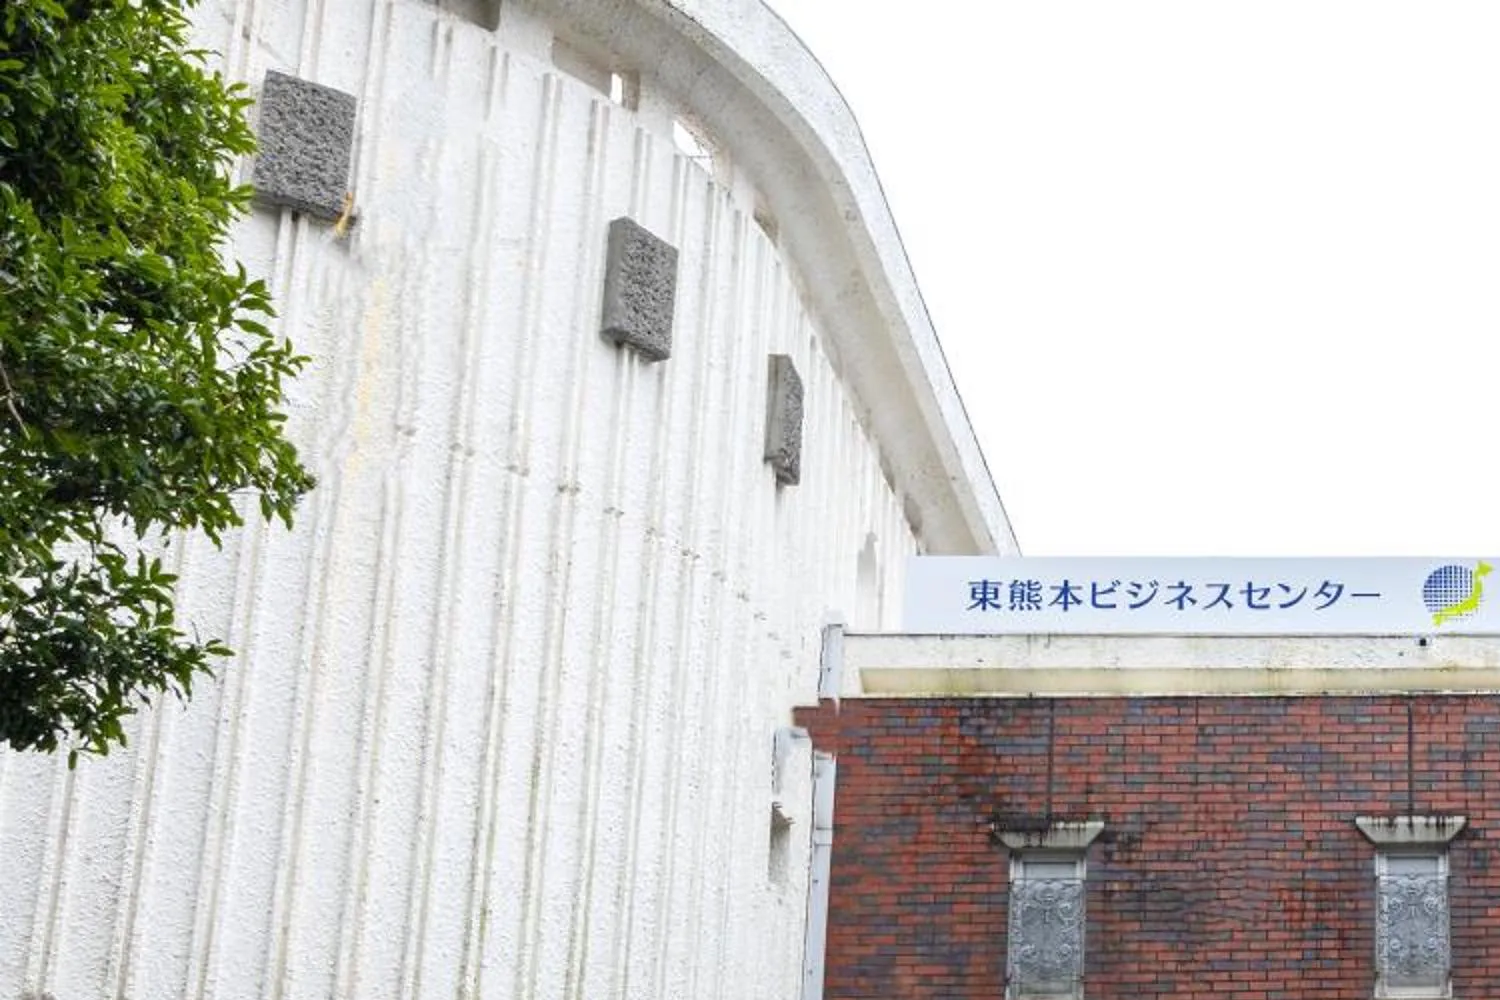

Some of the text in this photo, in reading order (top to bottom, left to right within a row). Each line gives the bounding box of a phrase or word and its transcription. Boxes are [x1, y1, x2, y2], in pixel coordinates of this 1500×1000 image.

[967, 579, 1381, 611] 東熊本ビジネスセンター
